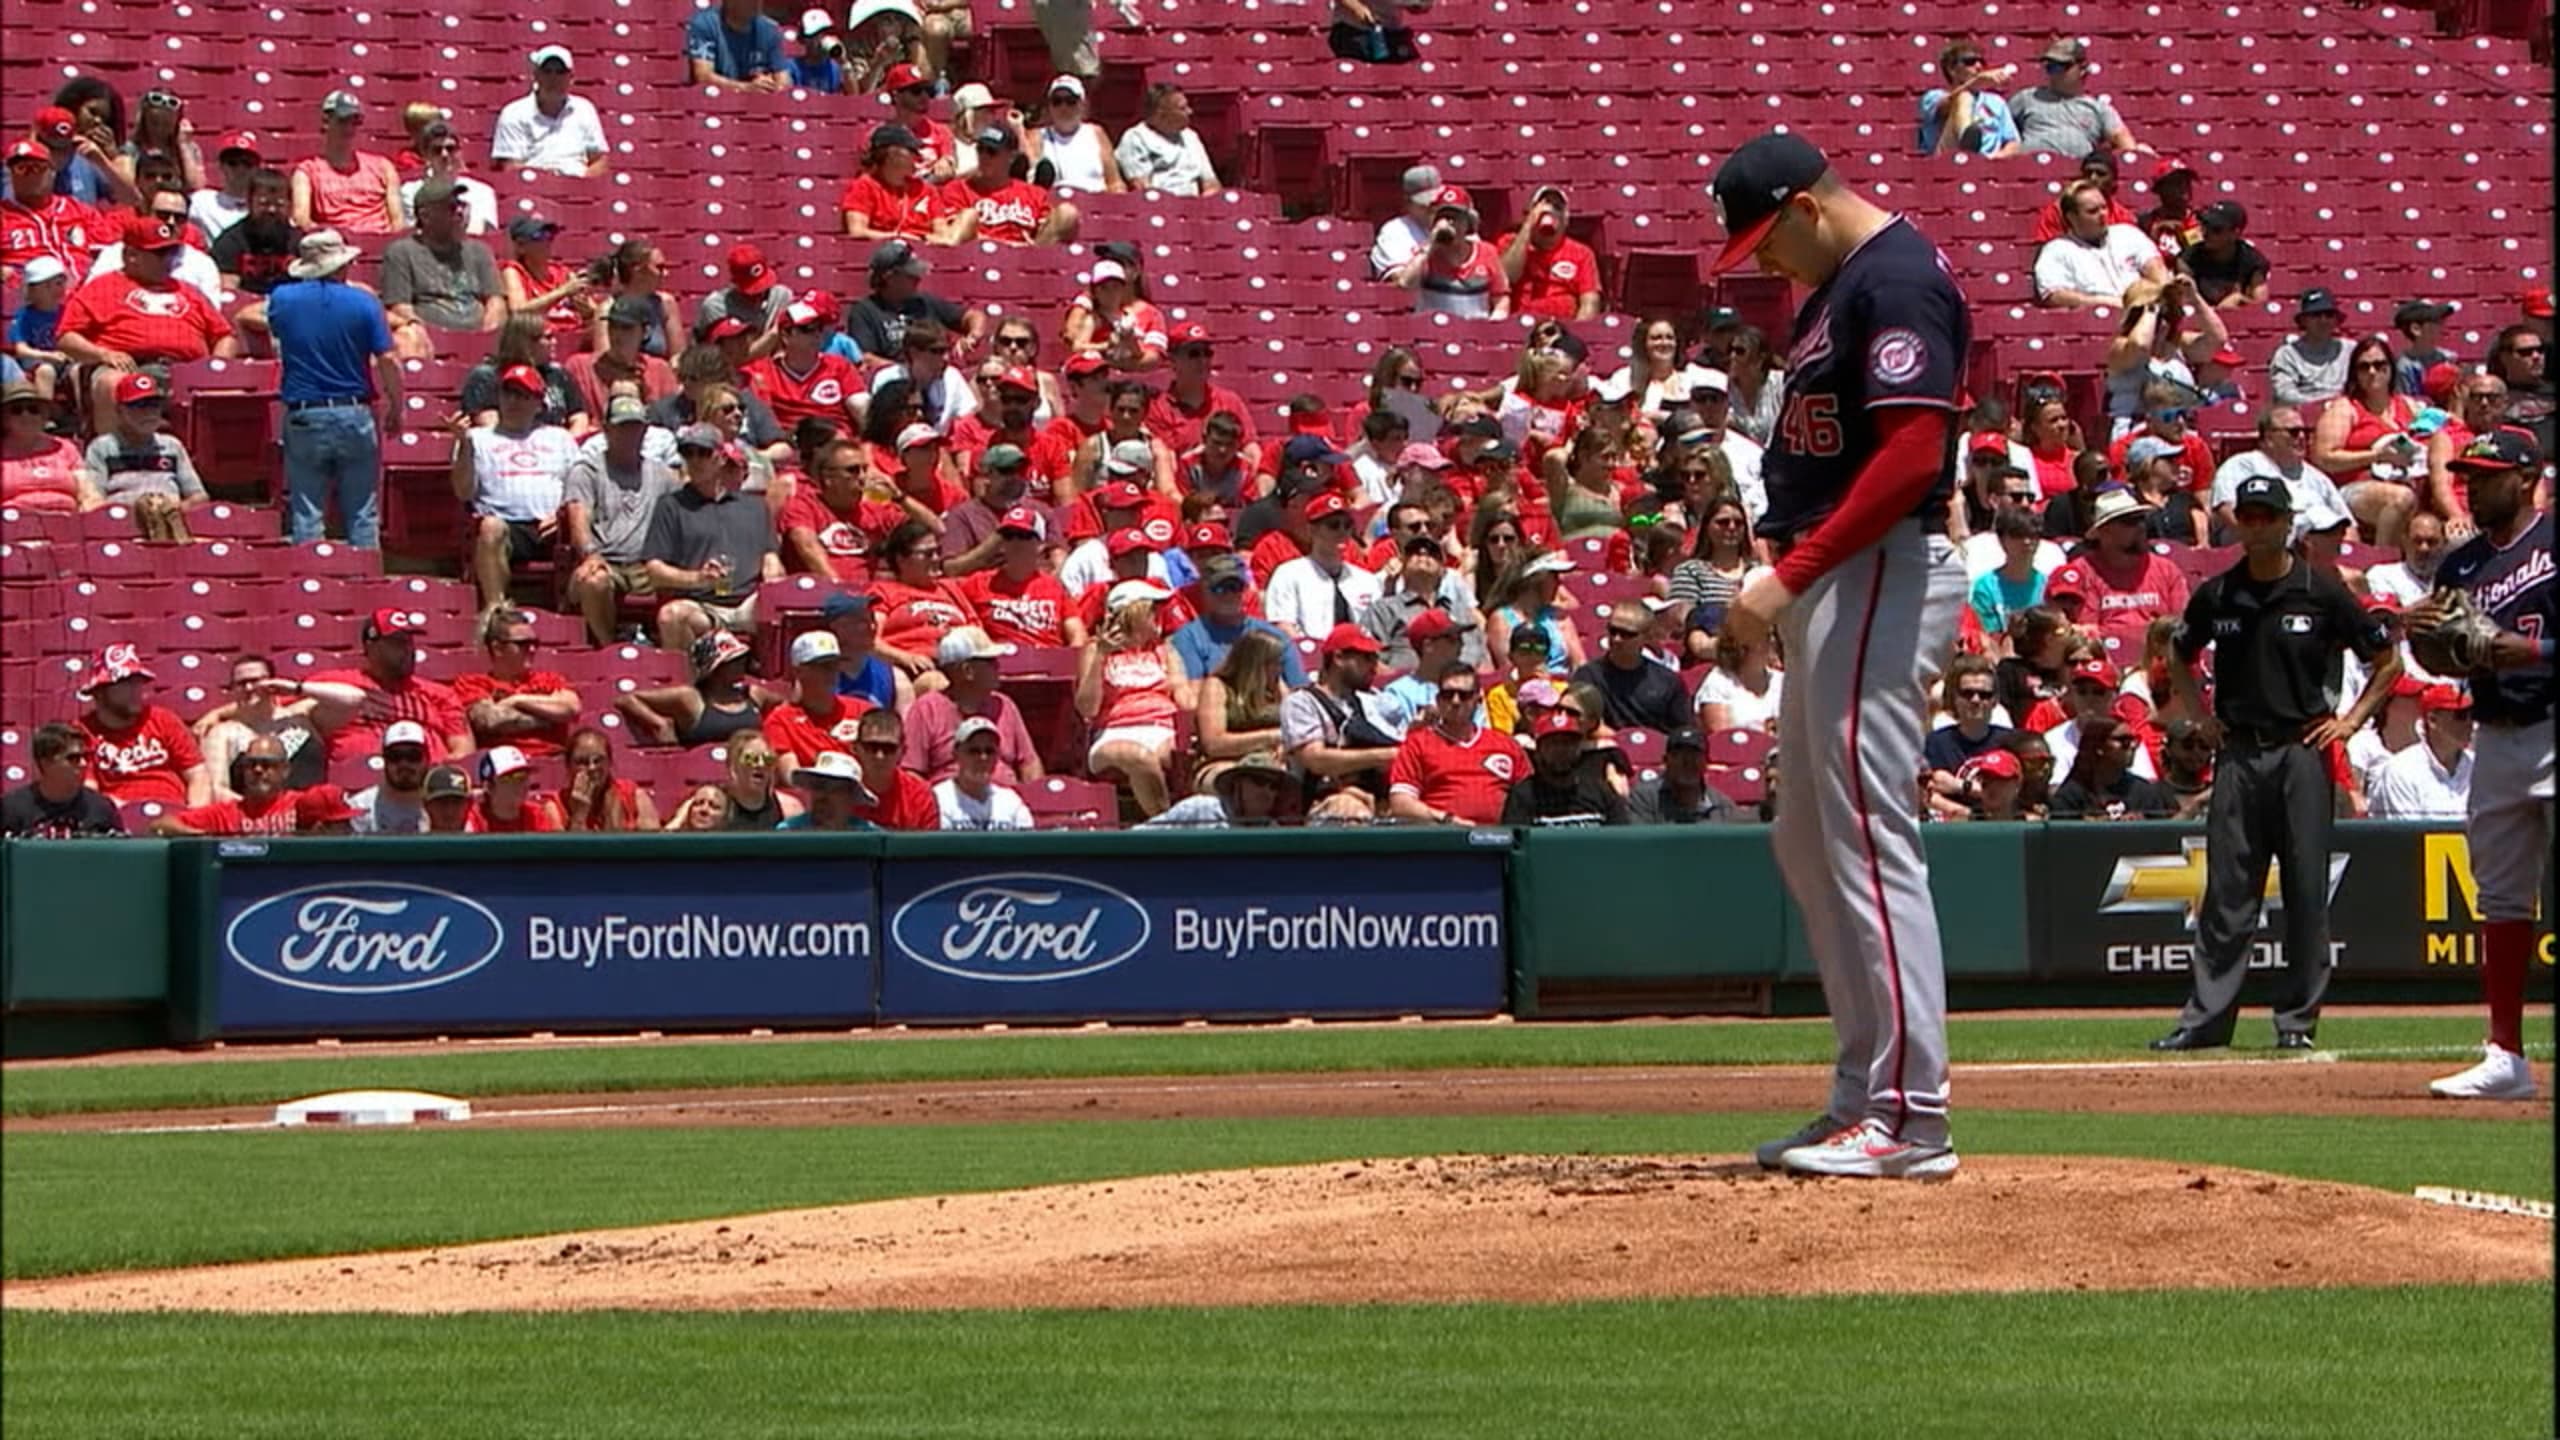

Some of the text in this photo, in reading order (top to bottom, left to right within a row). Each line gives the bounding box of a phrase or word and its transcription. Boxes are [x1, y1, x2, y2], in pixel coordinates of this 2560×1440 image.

[11, 228, 37, 250] 21
[975, 196, 1036, 228] Reds
[1783, 393, 1843, 456] 46
[2474, 549, 2557, 612] tionals
[96, 733, 169, 774] Reds
[281, 896, 870, 973] Ford BuyFordNow.com
[942, 887, 1498, 961] Ford BuyFordNow.com
